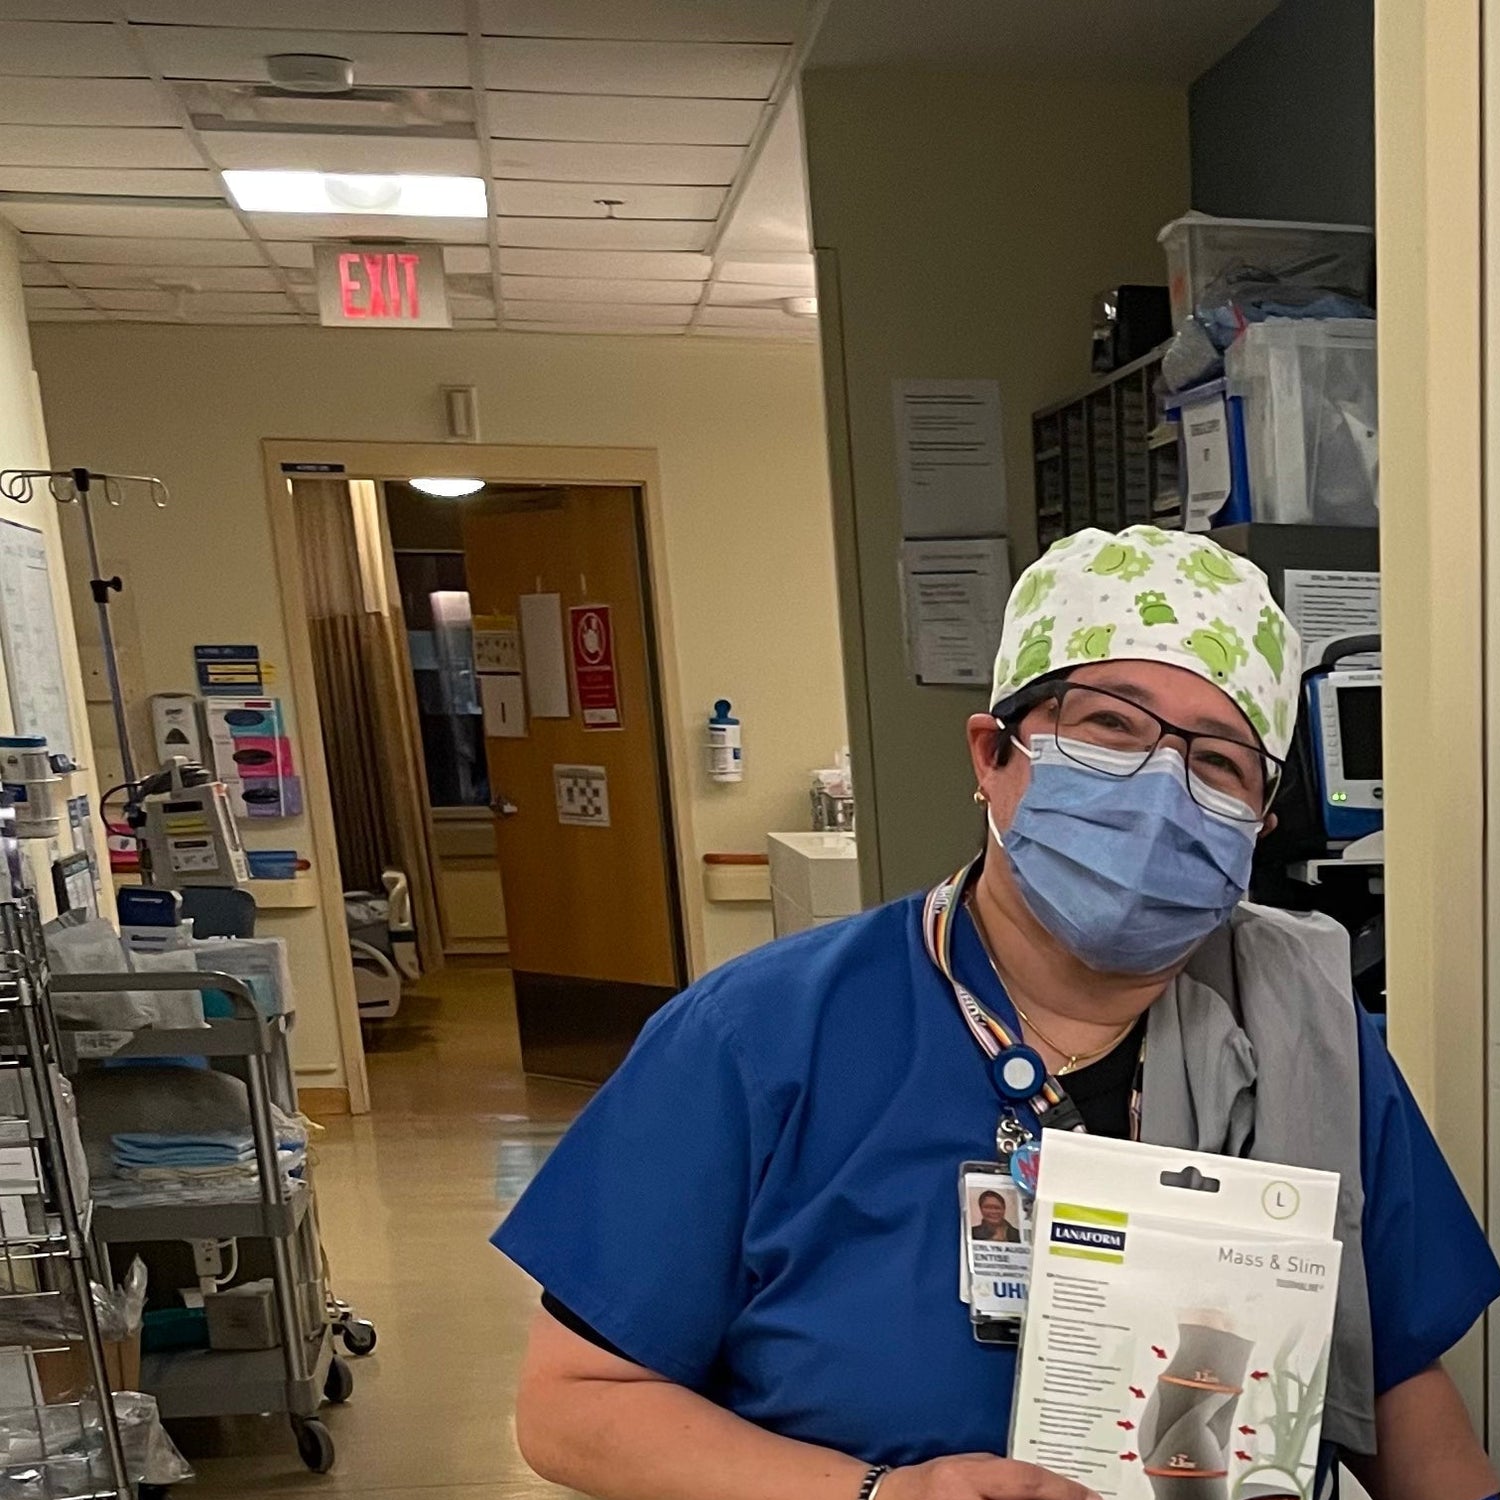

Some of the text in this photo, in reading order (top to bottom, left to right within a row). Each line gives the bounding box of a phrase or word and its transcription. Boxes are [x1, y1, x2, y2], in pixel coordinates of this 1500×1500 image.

[340, 253, 419, 319] EXIT
[1276, 1191, 1286, 1208] L
[1055, 1226, 1121, 1246] LANAFORM
[1218, 1246, 1326, 1277] Mass & Slim
